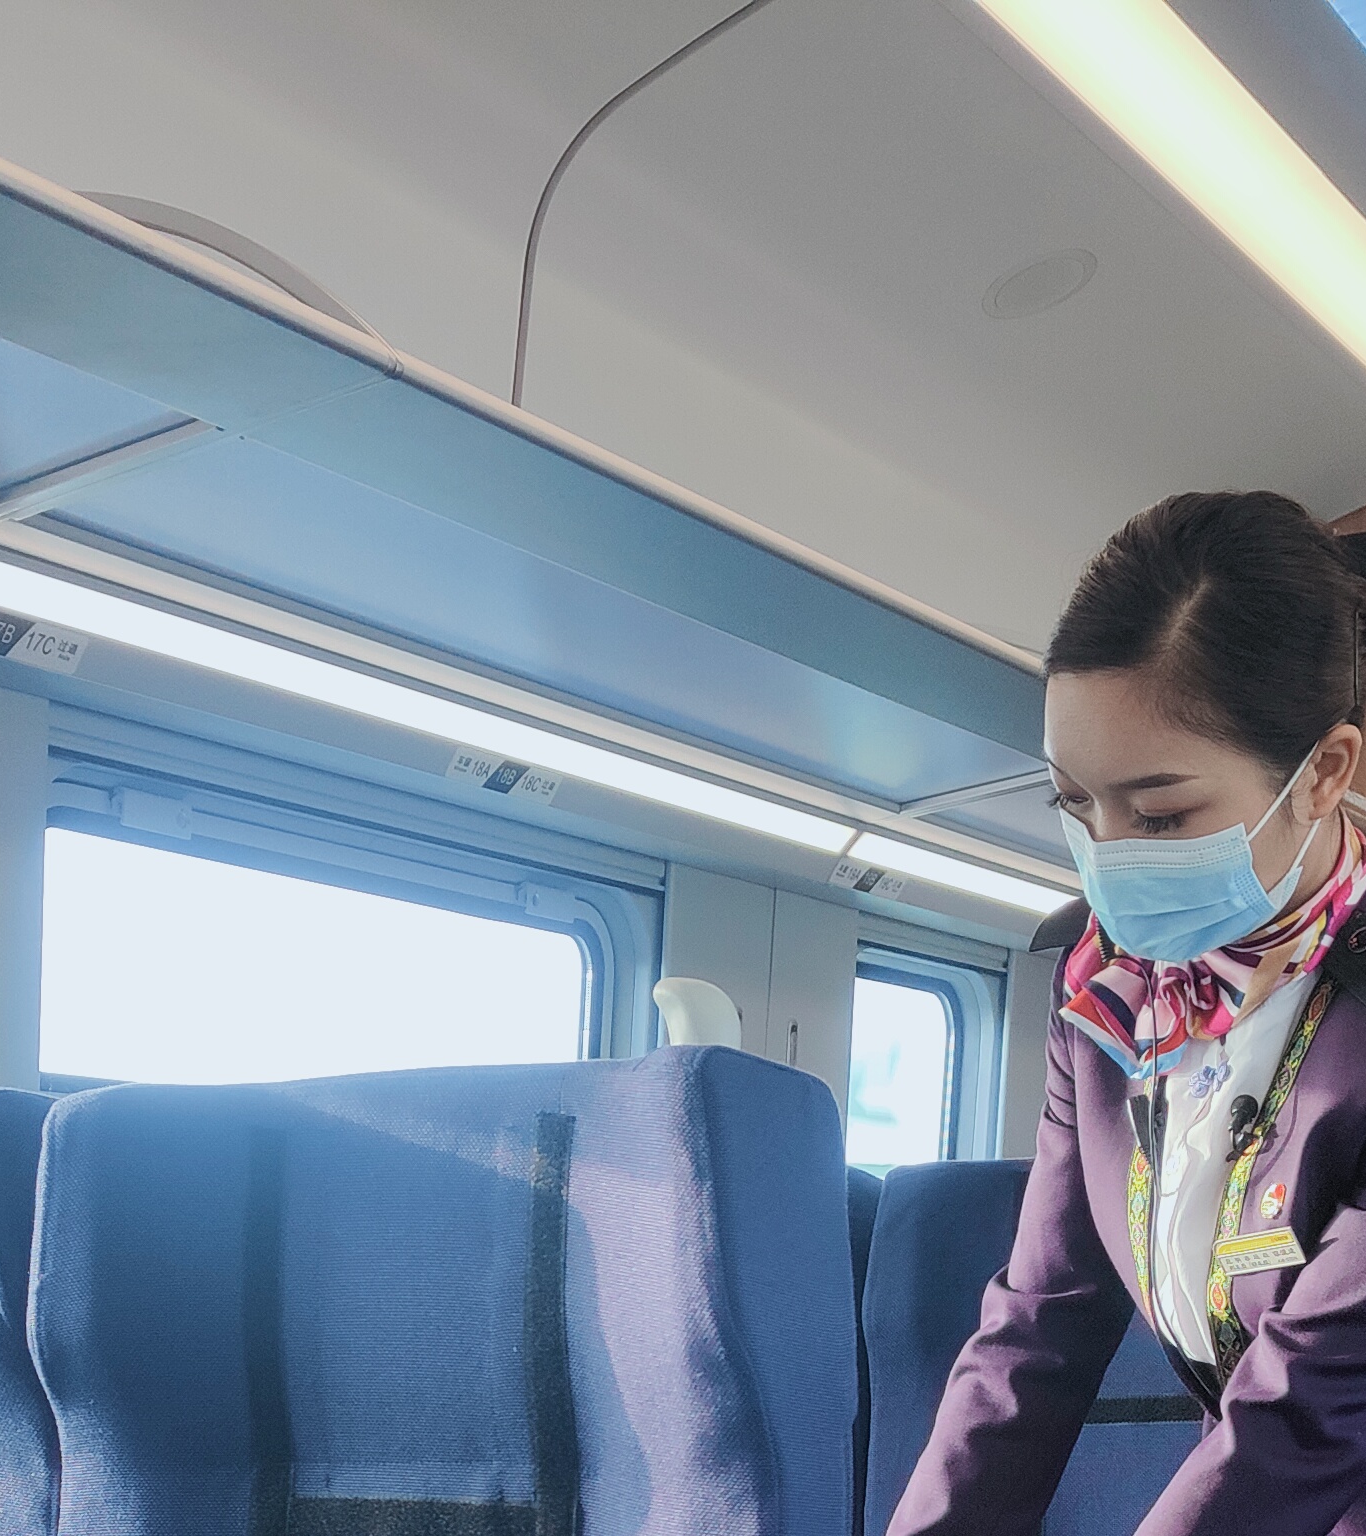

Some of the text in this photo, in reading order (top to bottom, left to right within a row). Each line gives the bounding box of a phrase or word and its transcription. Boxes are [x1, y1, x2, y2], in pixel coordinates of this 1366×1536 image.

[26, 631, 56, 655] 17C
[471, 760, 491, 778] 18A
[496, 767, 517, 786] 18B
[520, 774, 542, 792] 18C
